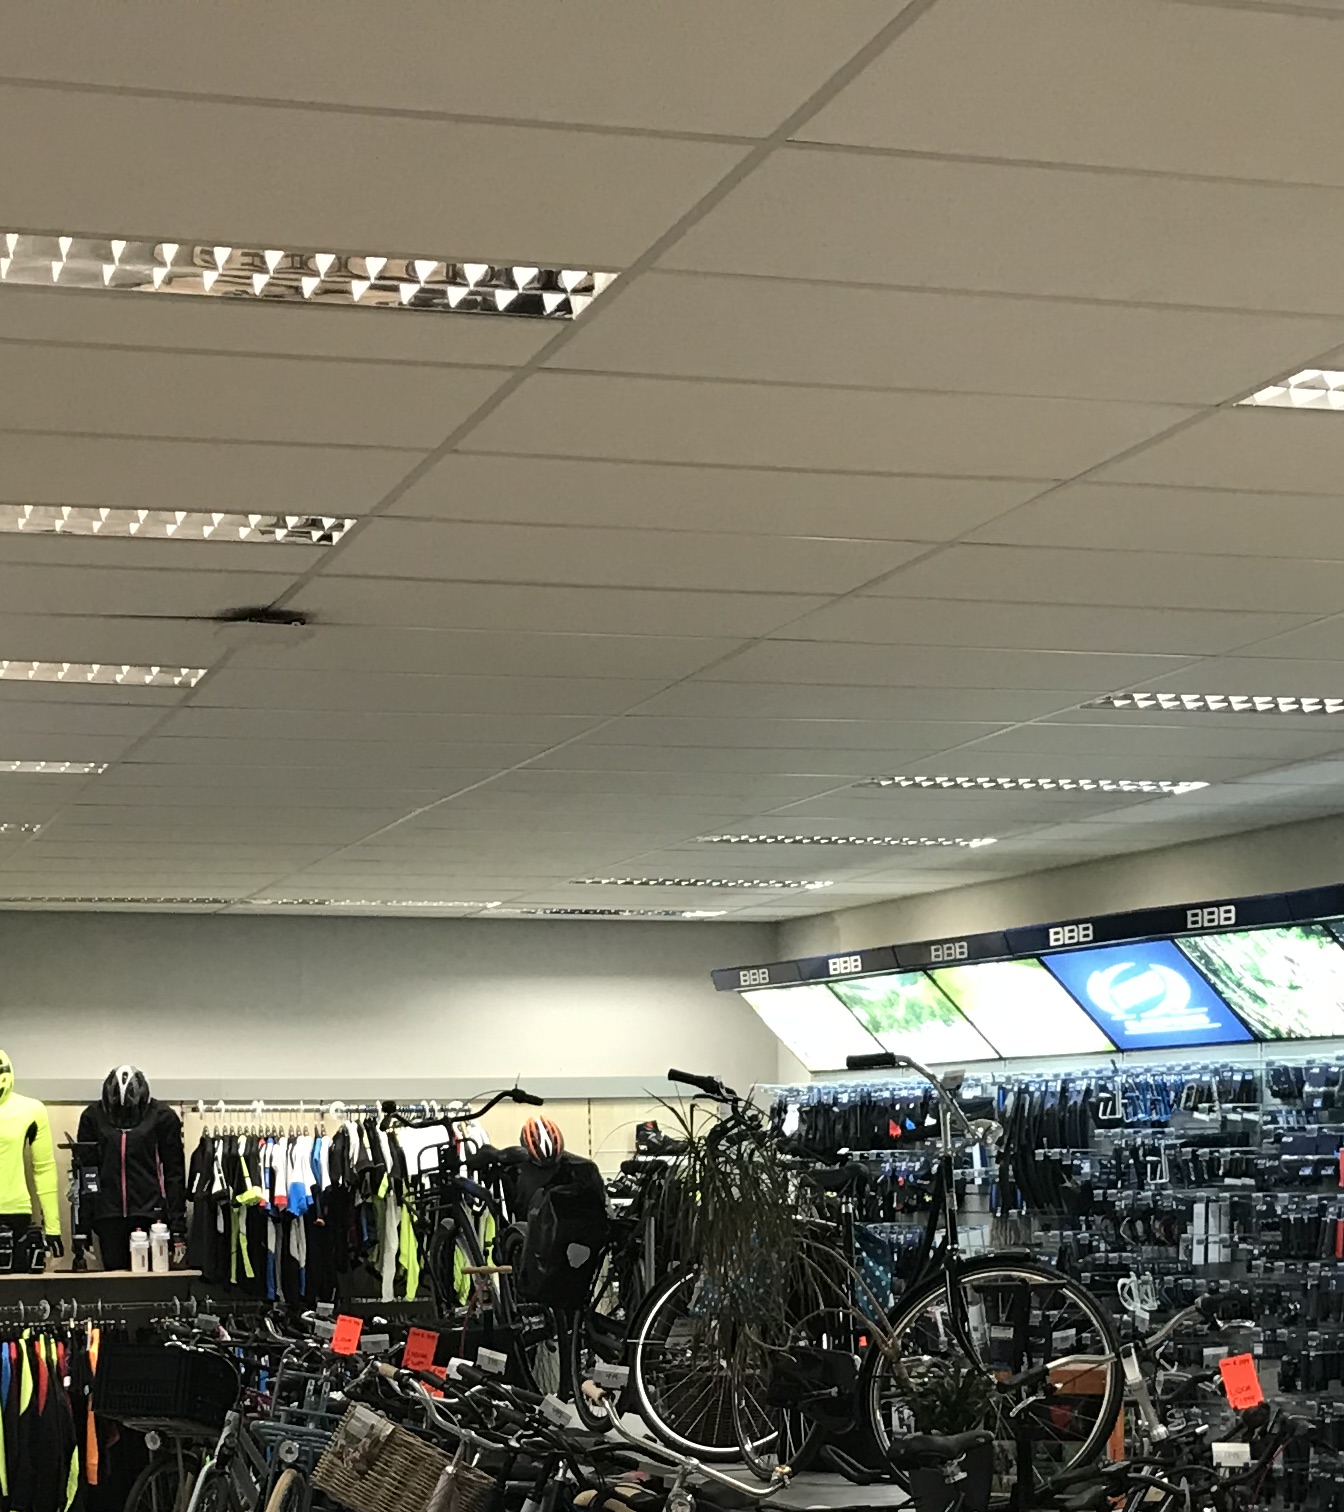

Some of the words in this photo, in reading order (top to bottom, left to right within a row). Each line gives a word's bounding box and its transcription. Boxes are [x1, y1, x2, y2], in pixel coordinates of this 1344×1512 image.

[1186, 905, 1236, 928] BBB
[1049, 923, 1094, 947] BBB
[930, 941, 968, 962] BBB
[828, 955, 862, 975] BBB
[739, 968, 770, 986] BBB
